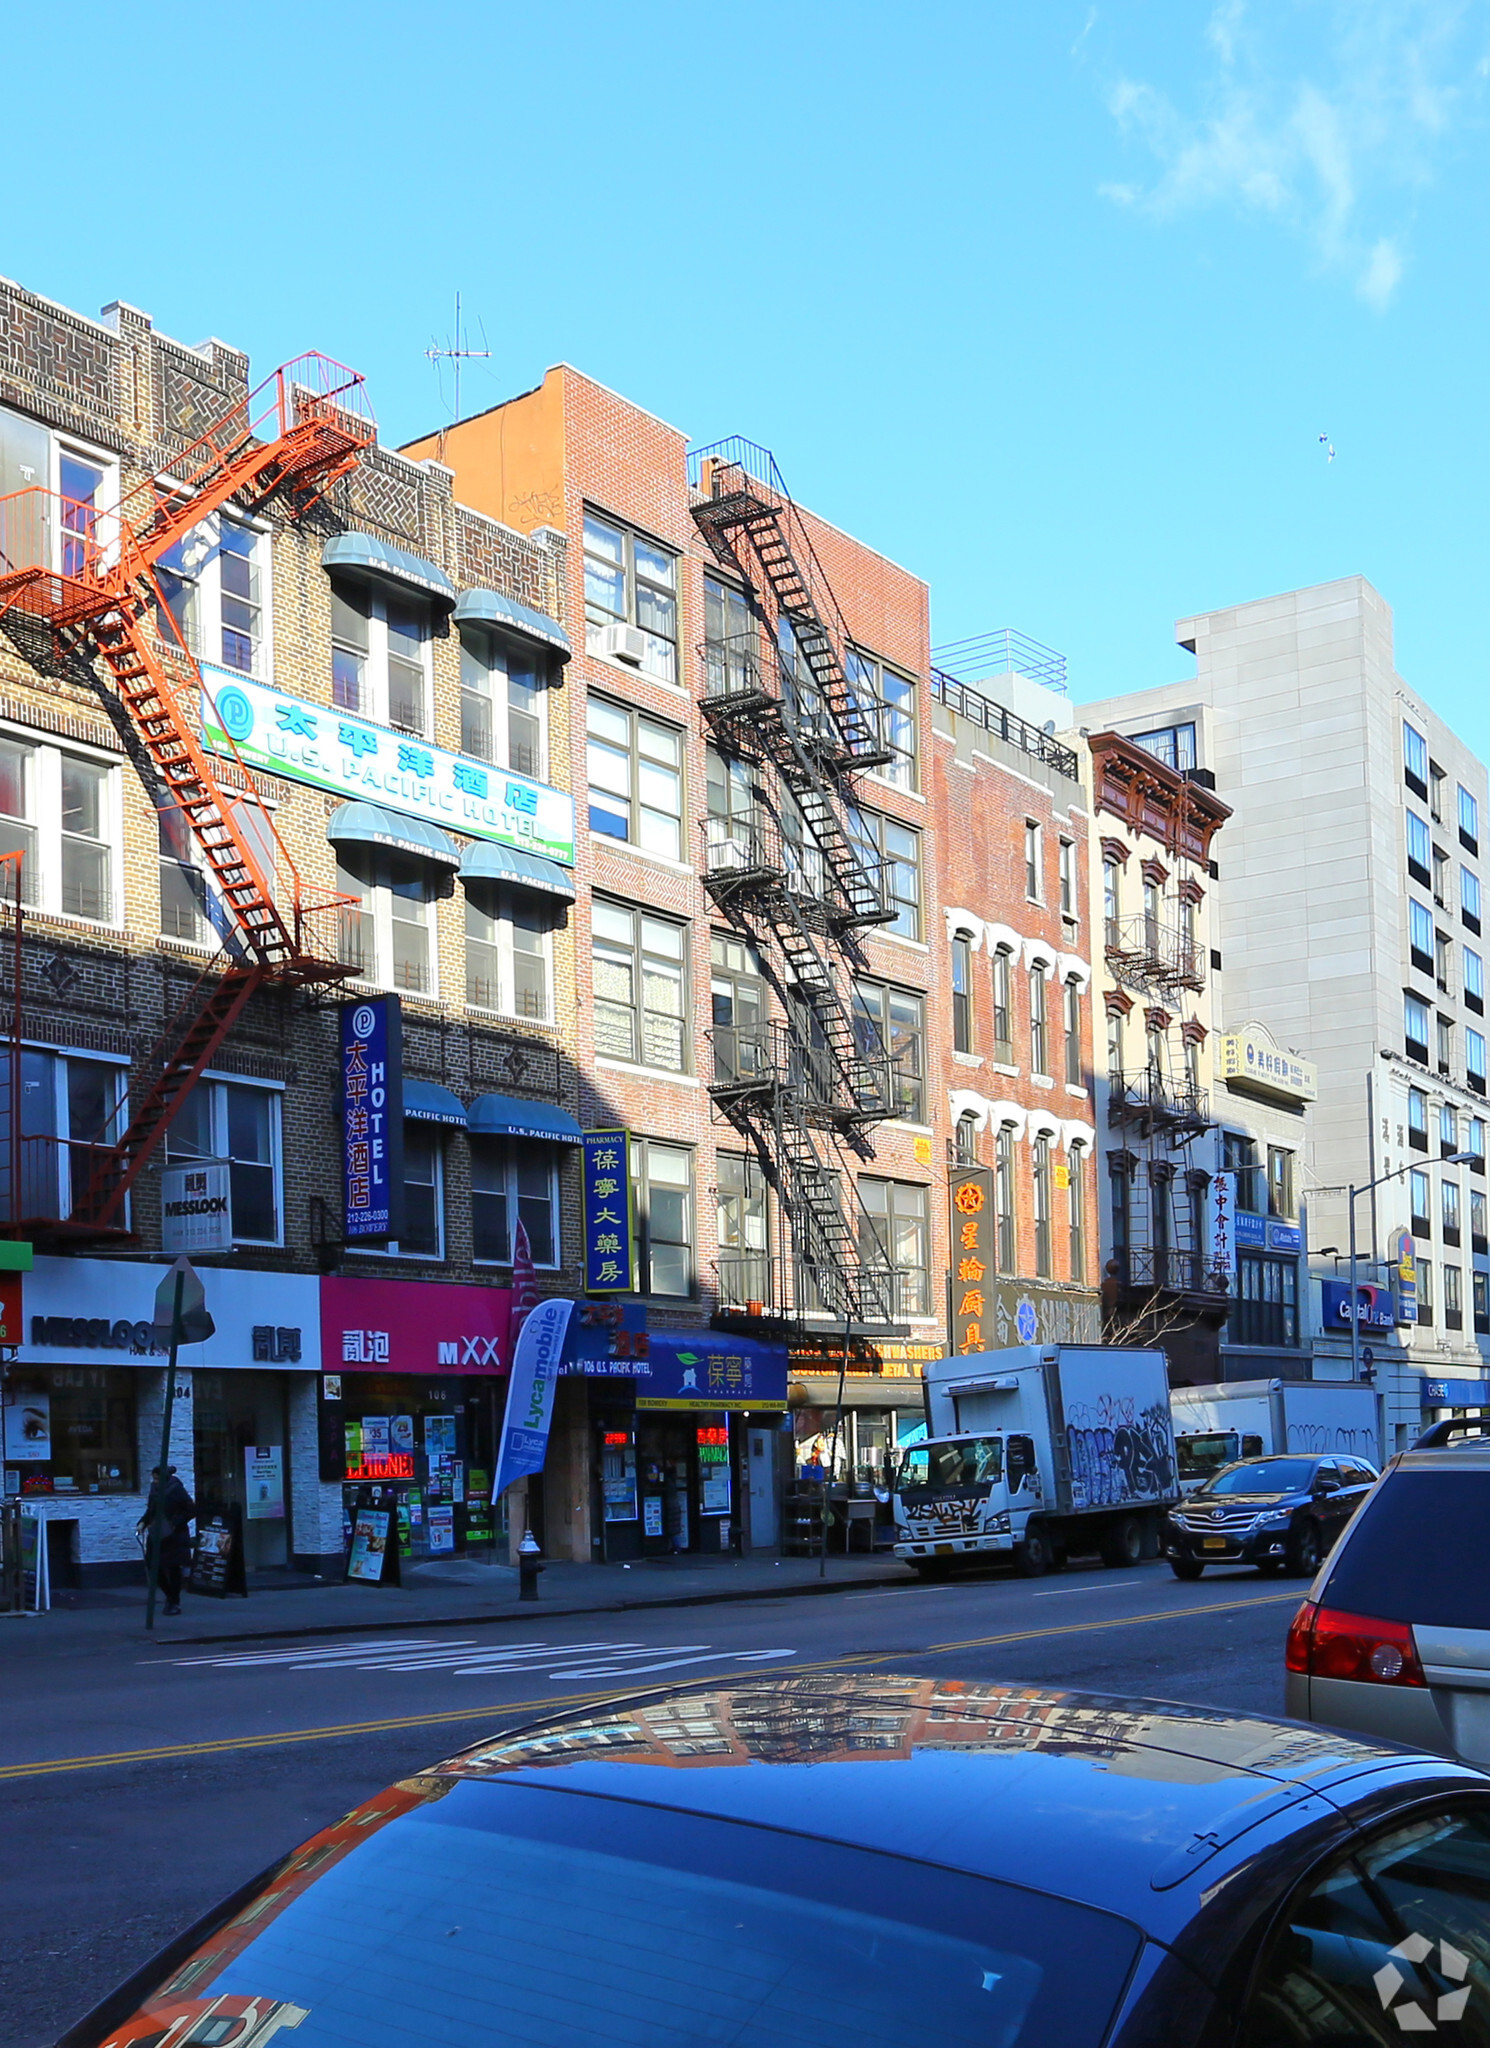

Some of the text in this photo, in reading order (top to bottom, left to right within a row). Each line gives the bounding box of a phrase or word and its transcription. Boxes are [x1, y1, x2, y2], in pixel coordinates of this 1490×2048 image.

[368, 557, 390, 573] U.S.
[393, 566, 428, 587] PACIFIC
[495, 611, 516, 626] U.S.
[518, 620, 549, 641] PACIFIC
[231, 744, 270, 765] OWERY
[275, 703, 538, 816] 太平洋酒店
[267, 733, 544, 842] U.S. PACIFIC HOTEL
[373, 832, 460, 867] U.S. PACIFIC HOTEL
[501, 870, 576, 899] U.S. PACIFIC HOTEL
[345, 1040, 371, 1209] 太平洋酒店
[371, 1061, 385, 1185] HOTEL
[405, 1108, 467, 1126] PACIFIC HOTEL
[508, 1126, 583, 1145] U.S. PACIFIC HOTEL
[586, 1135, 624, 1145] PHARMACY
[165, 1197, 227, 1218] MESSLOOK
[347, 1209, 388, 1224] 212-226-0300
[592, 1148, 624, 1283] 葆寧大藥房
[1339, 1300, 1367, 1323] Captal
[31, 1315, 160, 1350] MESSLOO
[342, 1330, 389, 1364] 亂泡
[523, 1307, 558, 1429] Lycamobile
[609, 1361, 631, 1373] PACIFIC
[707, 1353, 743, 1388] 葆寧
[428, 1390, 447, 1400] 106
[524, 1436, 544, 1448] Lyca
